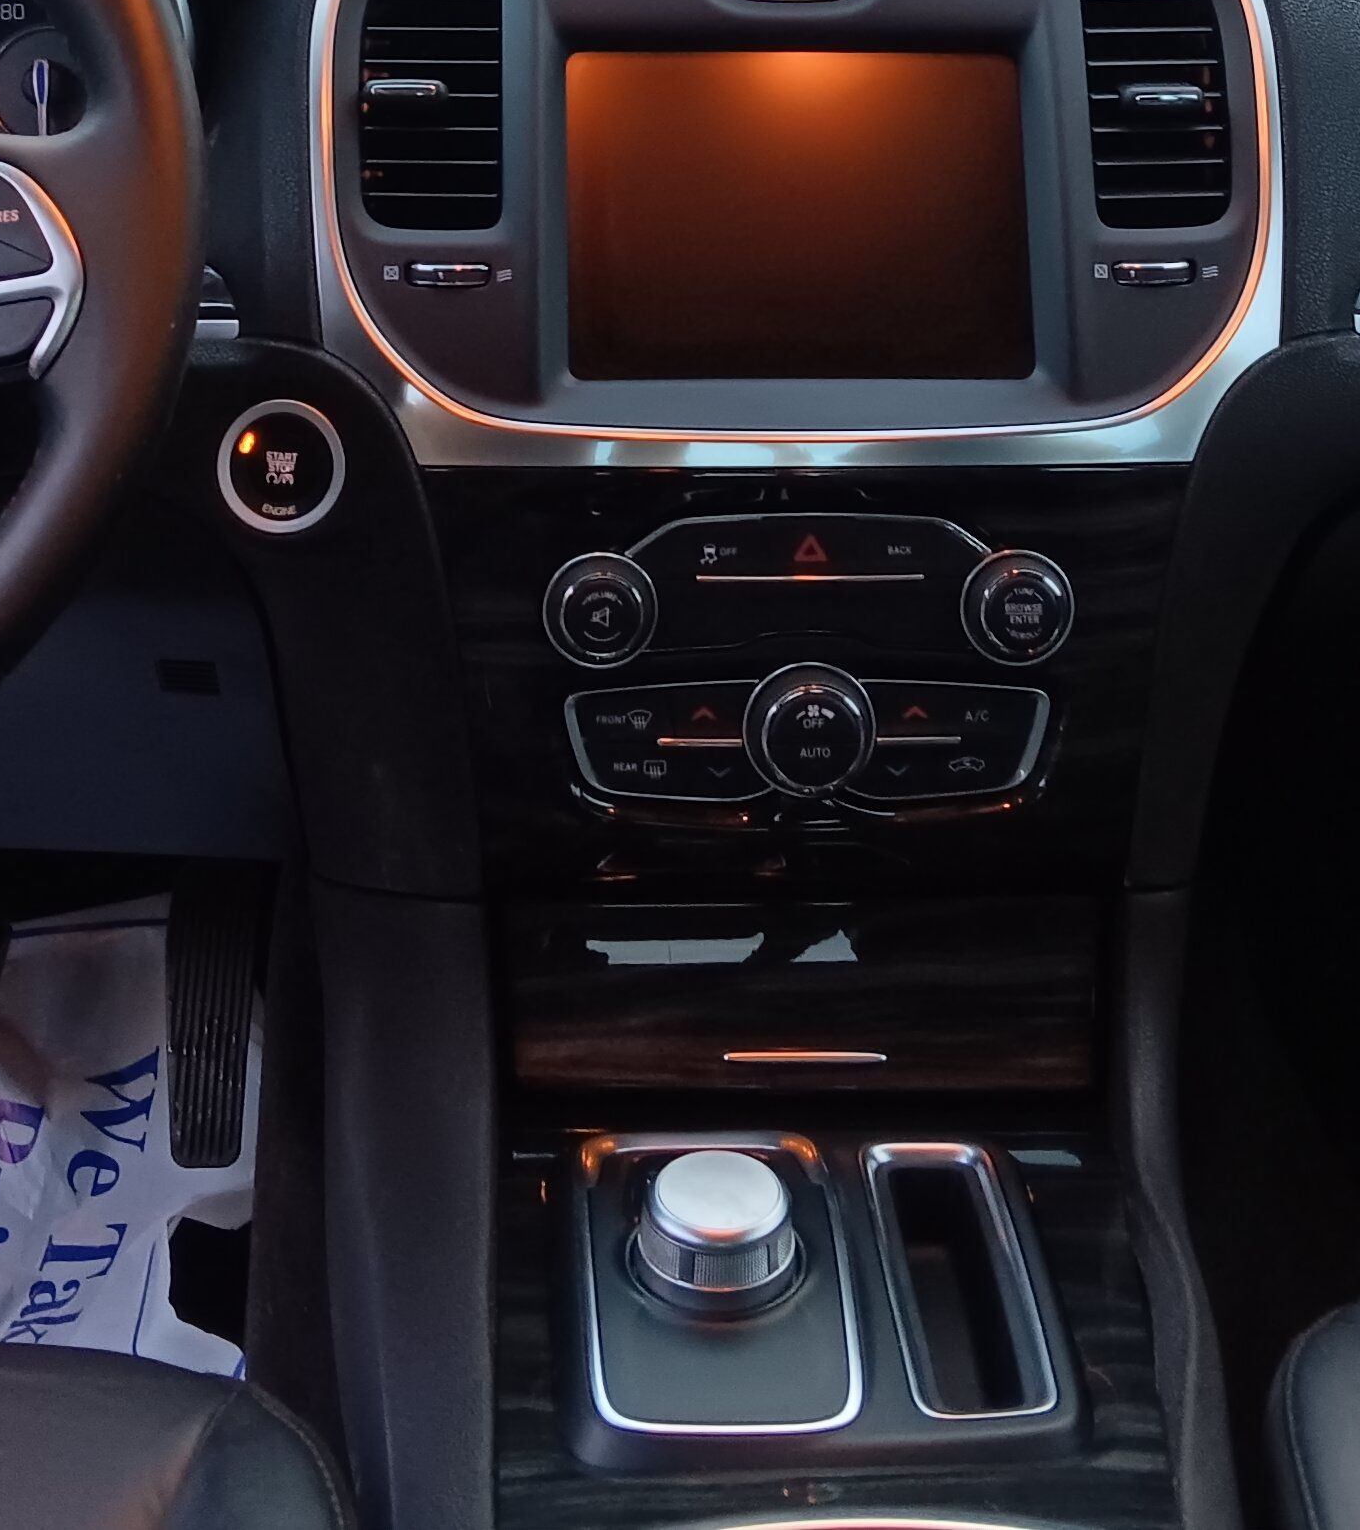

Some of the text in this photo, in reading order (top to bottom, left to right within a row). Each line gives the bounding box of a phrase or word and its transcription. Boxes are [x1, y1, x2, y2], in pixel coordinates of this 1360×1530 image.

[0, 3, 25, 21] 80
[266, 451, 298, 463] START
[268, 461, 295, 473] STOP
[719, 547, 738, 556] OFF
[887, 545, 912, 556] BACK
[1004, 603, 1042, 613] BROWSE
[1009, 614, 1040, 624] ENTER
[596, 715, 627, 725] FRONT
[965, 710, 990, 722] A/C
[802, 719, 824, 730] OFF
[799, 748, 831, 759] AUTO
[613, 762, 638, 772] REAR
[1, 1045, 160, 1344] We Tak
